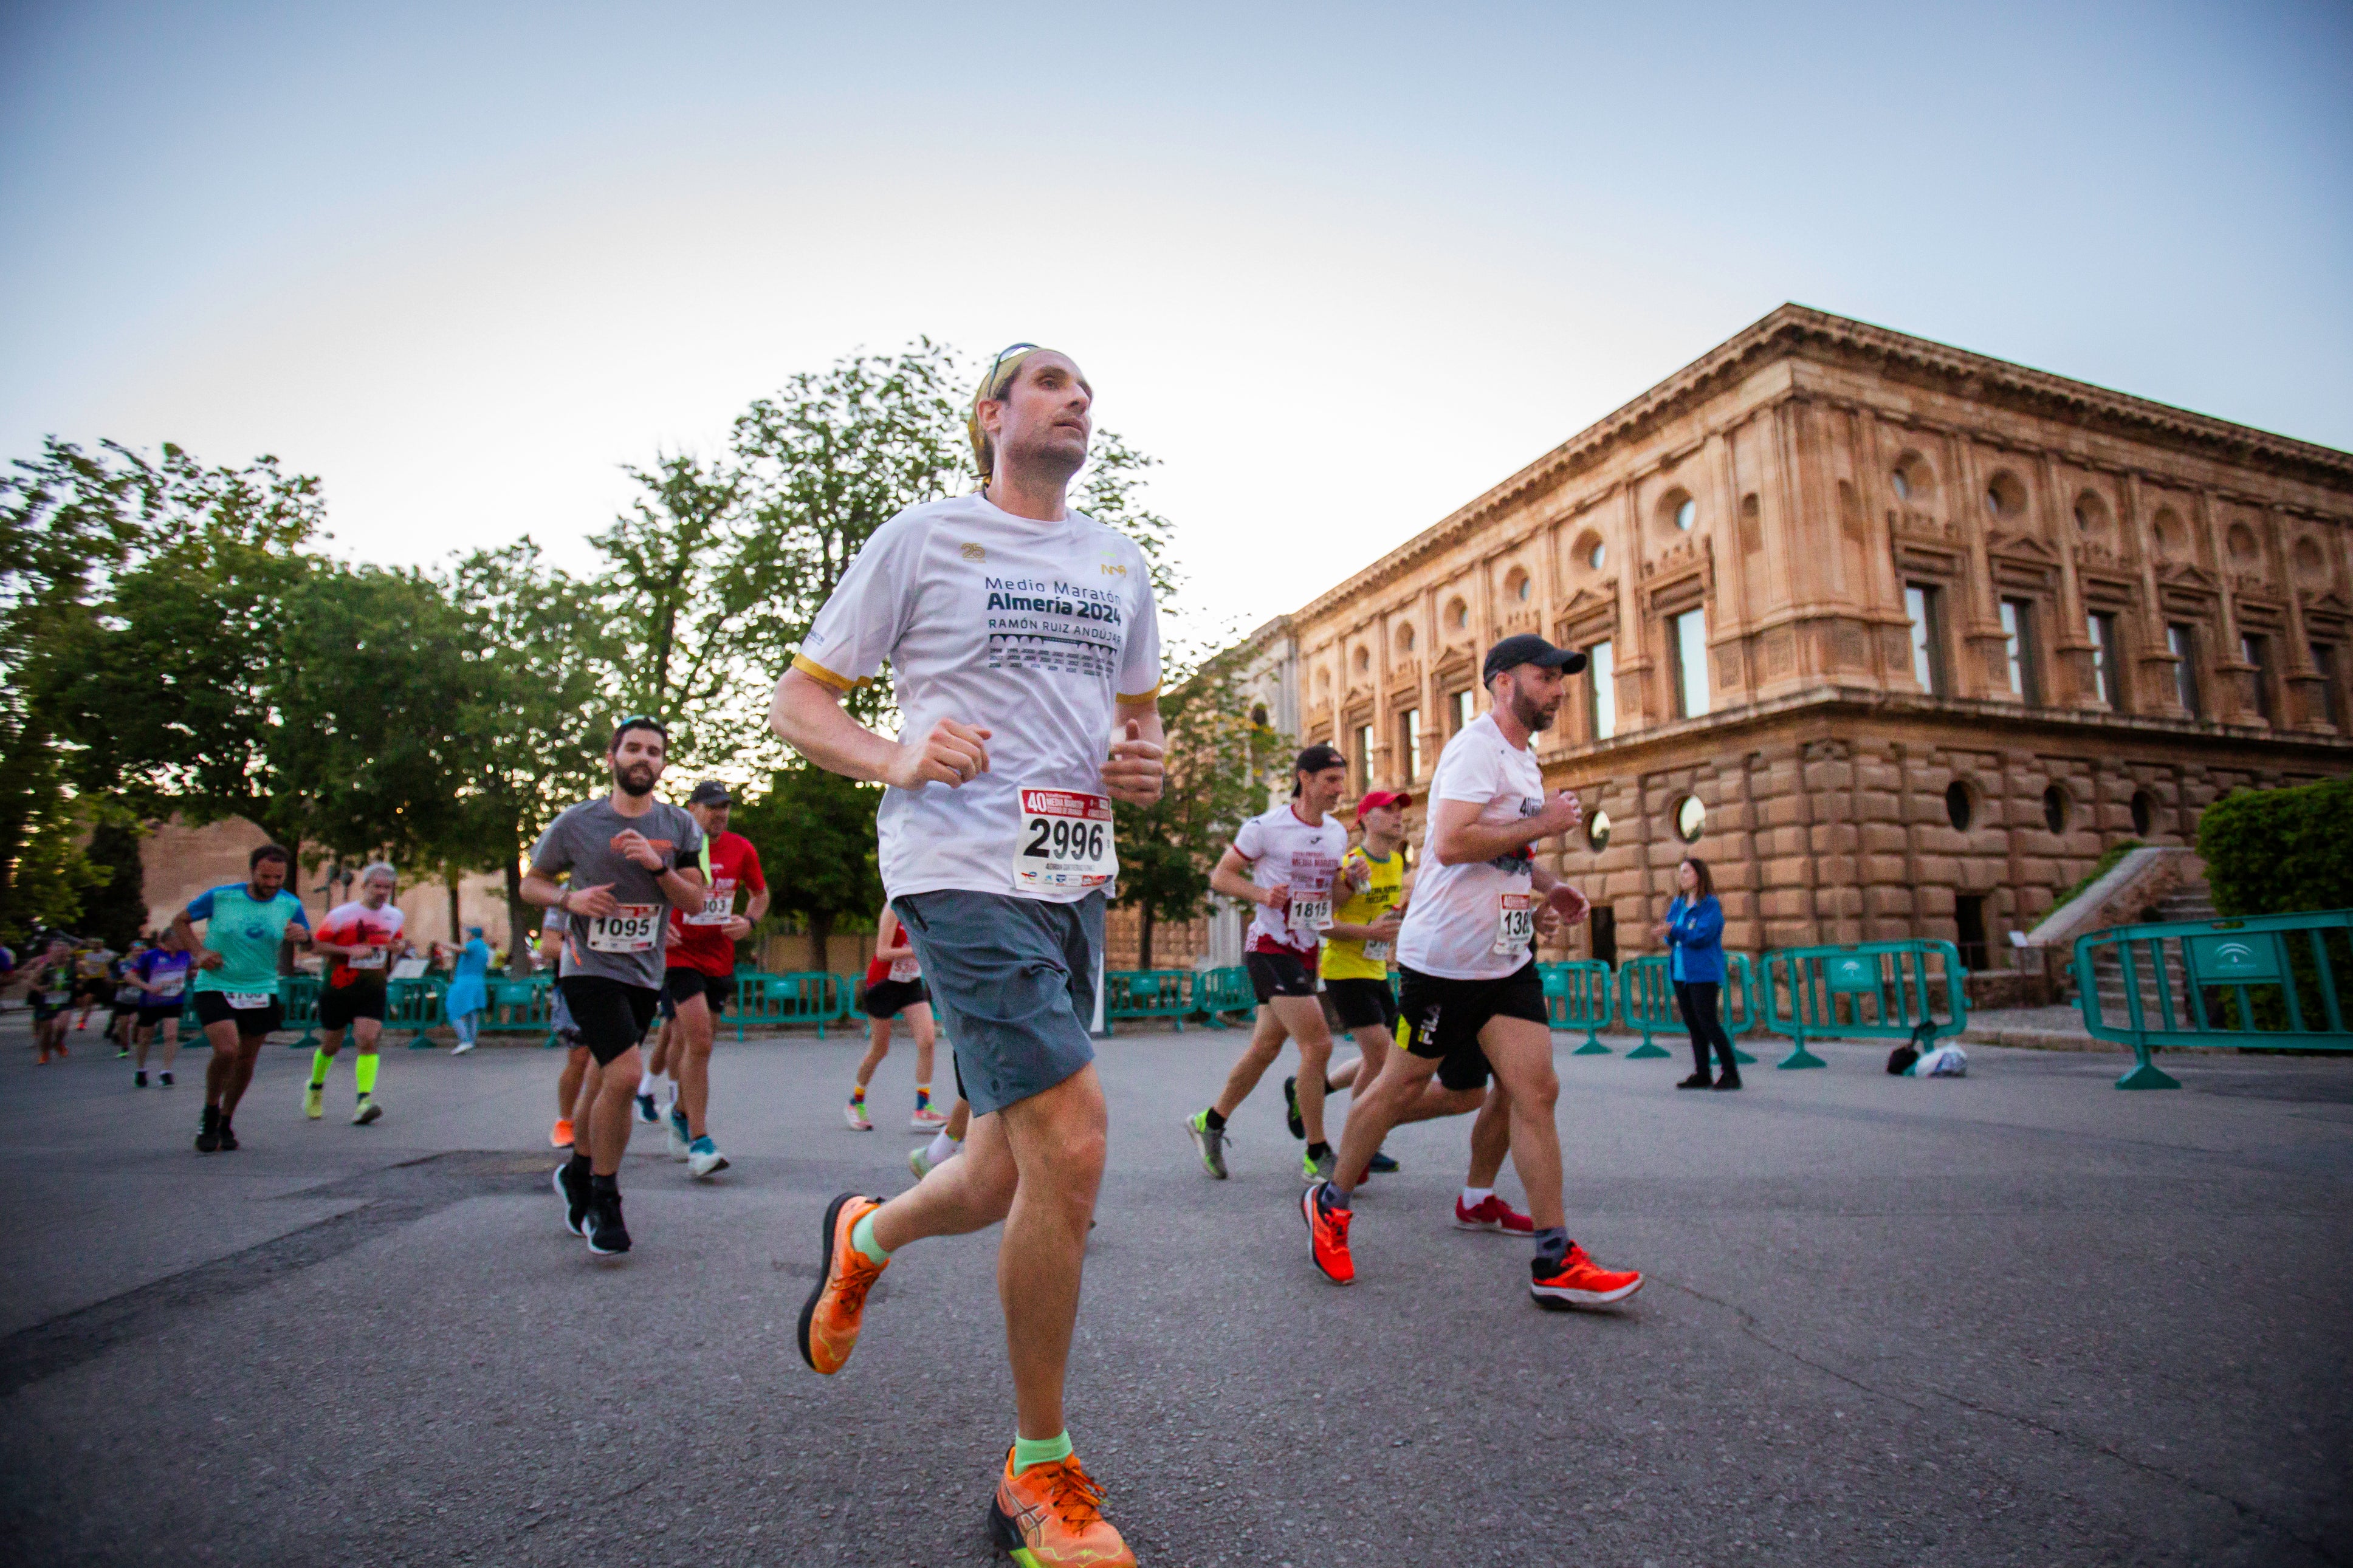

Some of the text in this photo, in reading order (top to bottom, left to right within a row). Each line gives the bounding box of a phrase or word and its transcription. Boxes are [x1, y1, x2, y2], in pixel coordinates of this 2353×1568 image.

[961, 543, 985, 559] 25
[986, 577, 1121, 605] Medio Maratón
[987, 592, 1121, 626] Almería 2024
[989, 617, 1121, 645] RAMÓN RUIZ ANDÚJAR
[1028, 792, 1046, 813] 40
[1023, 818, 1104, 861] 2996
[595, 917, 650, 937] 1095
